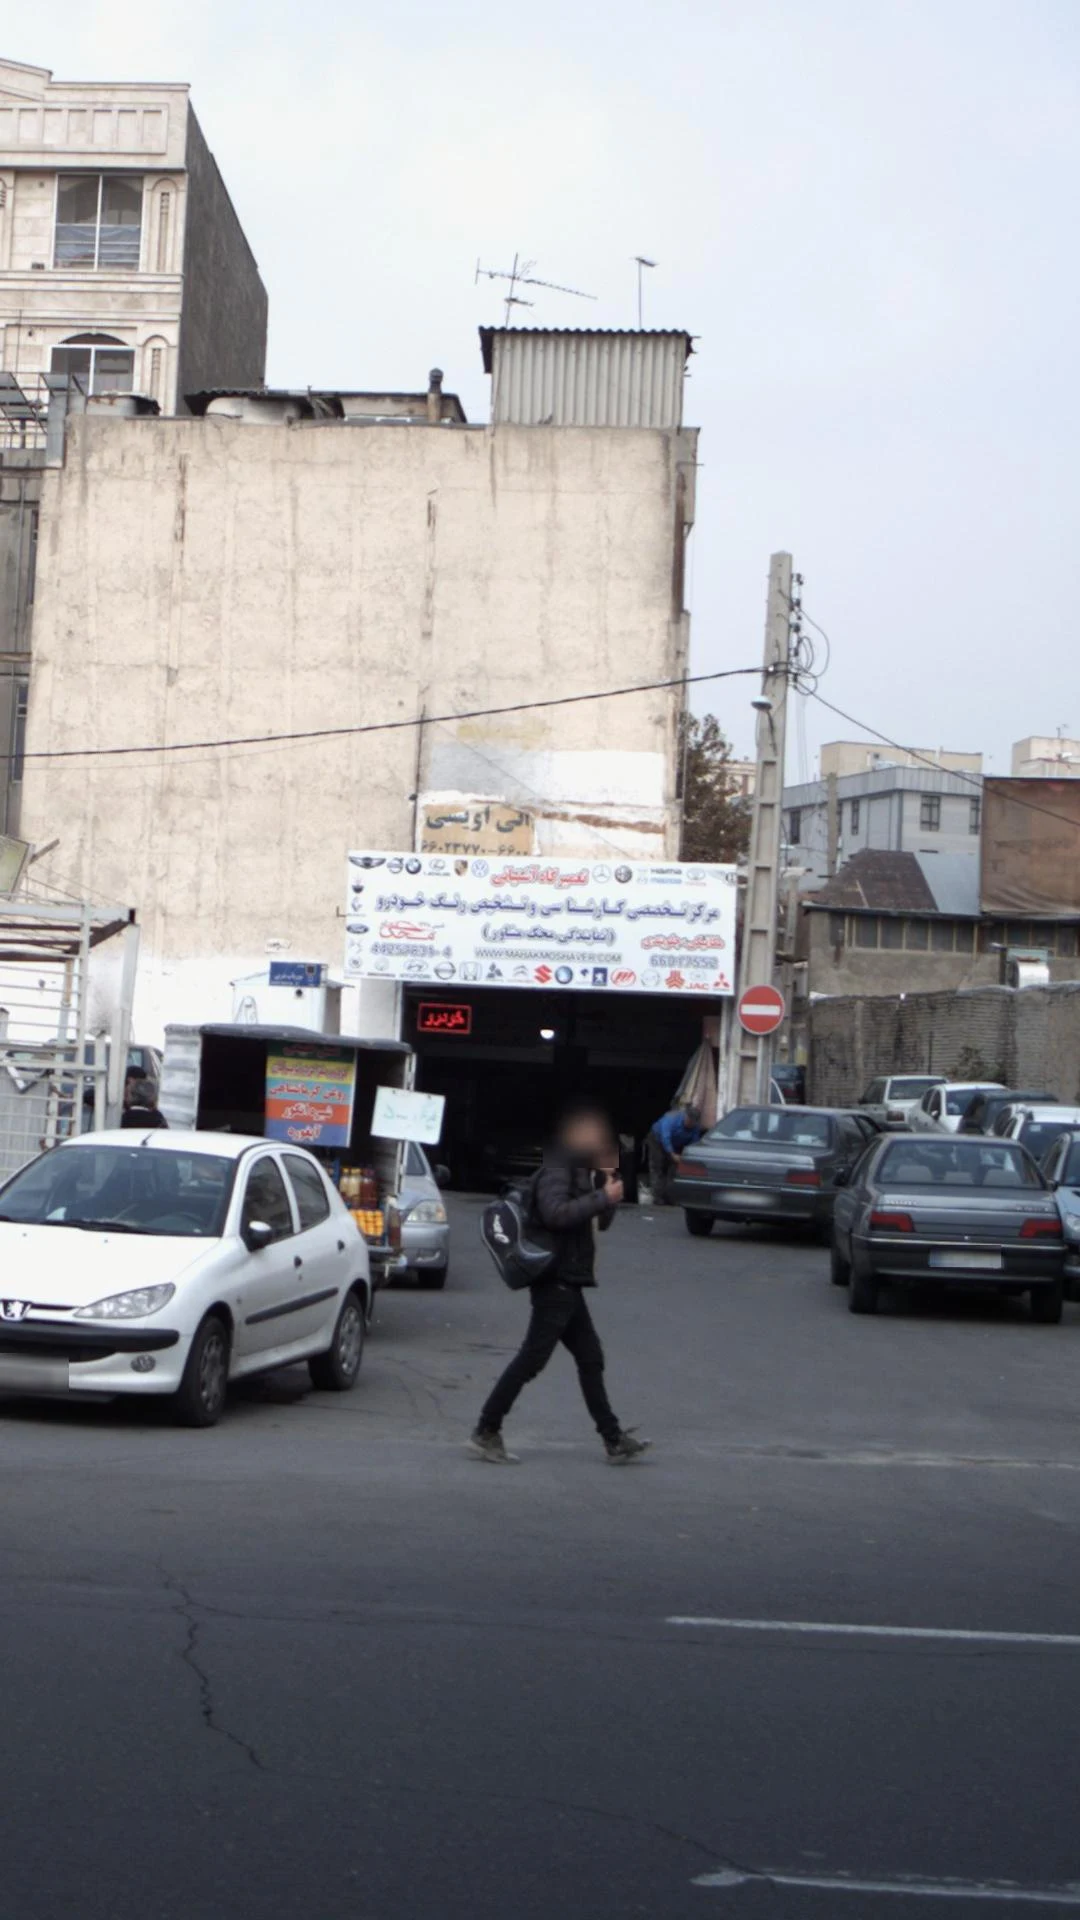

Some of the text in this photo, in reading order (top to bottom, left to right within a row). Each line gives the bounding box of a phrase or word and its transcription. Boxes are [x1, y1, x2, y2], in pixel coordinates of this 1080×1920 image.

[375, 890, 425, 912] خودرو
[429, 891, 467, 916] رنگ
[470, 893, 530, 916] تشخیص
[627, 899, 687, 921] تخصصی
[687, 901, 721, 923] مرکز
[686, 982, 710, 990] JAC
[425, 1010, 465, 1028] خودرو
[281, 1102, 333, 1121] شیره انگور
[287, 1123, 323, 1142] آبغوره
